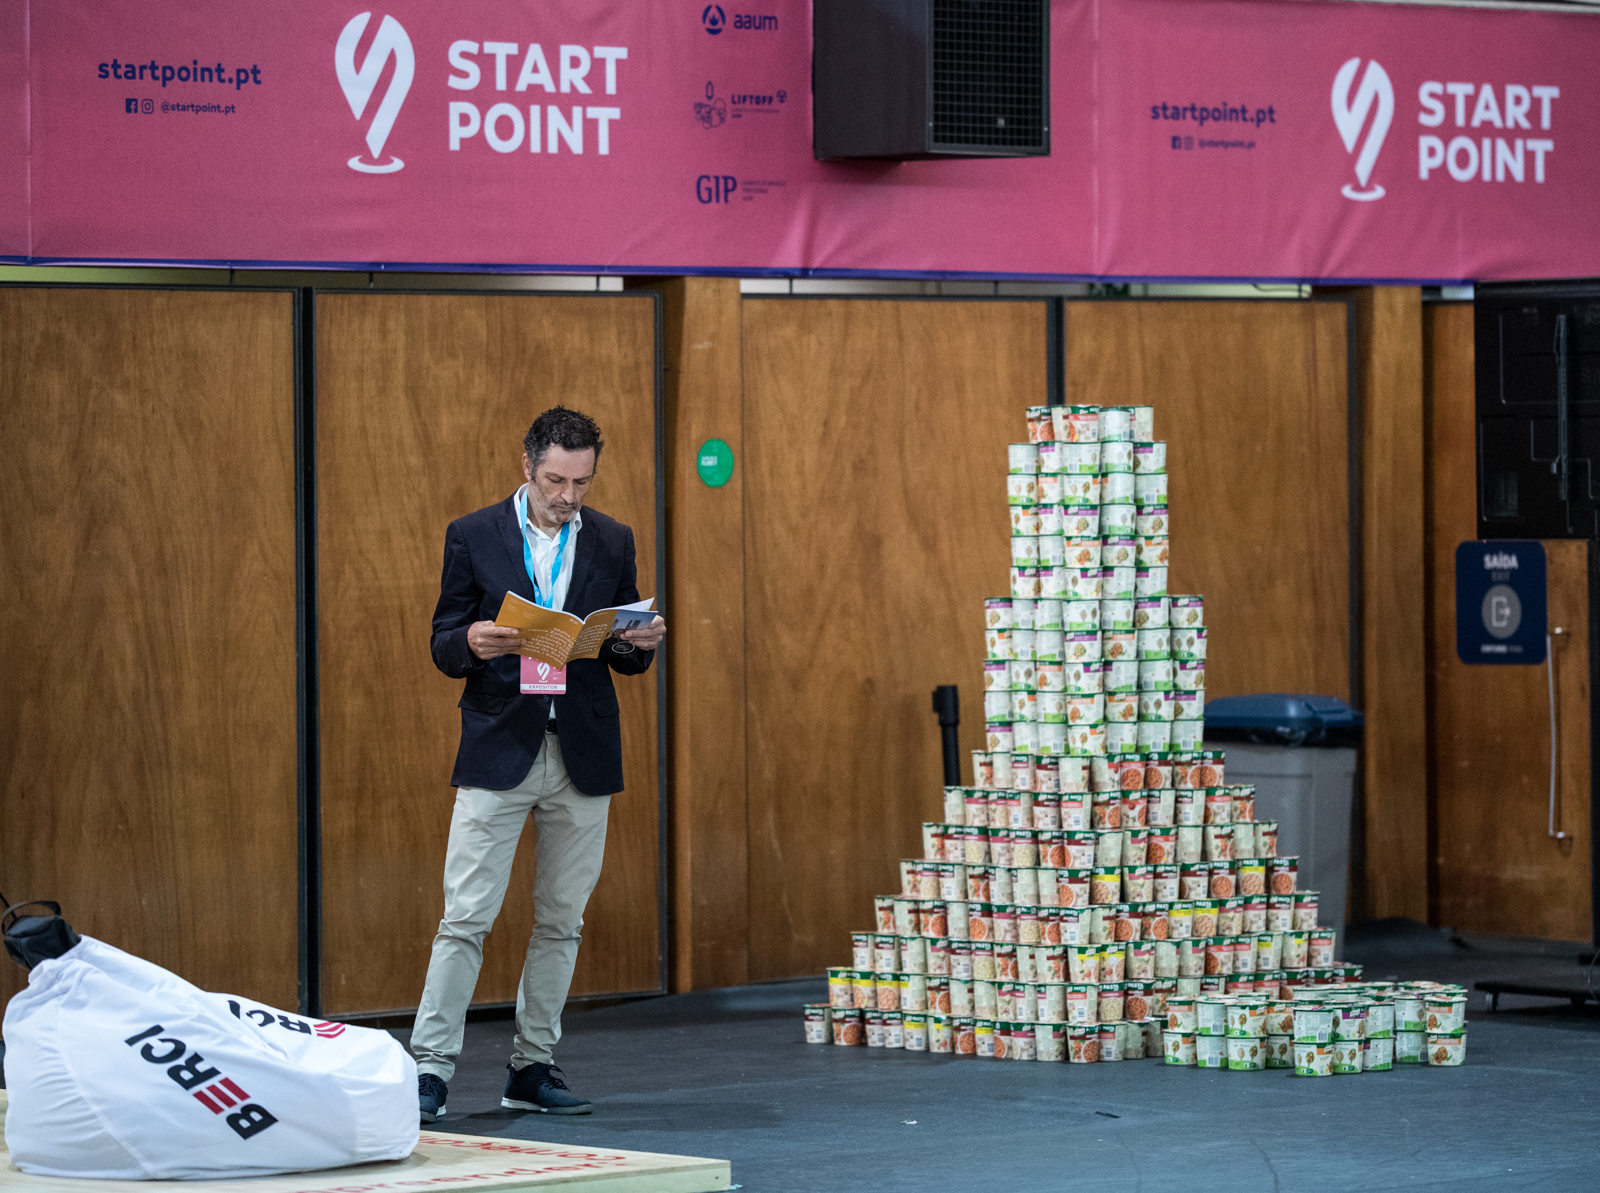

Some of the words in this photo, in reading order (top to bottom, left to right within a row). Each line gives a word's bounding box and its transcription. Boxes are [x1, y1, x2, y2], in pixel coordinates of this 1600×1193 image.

[734, 14, 778, 31] aaum
[98, 59, 262, 90] startpoint.pt
[448, 39, 628, 95] START
[161, 101, 236, 116] @startpoint.pt
[731, 94, 774, 106] LIFTOFF
[1151, 102, 1276, 128] startpoint.pt
[1418, 81, 1560, 130] START
[449, 101, 621, 155] POINT
[1418, 135, 1554, 183] POINT
[696, 174, 738, 204] GIP
[124, 1024, 279, 1140] BERCI
